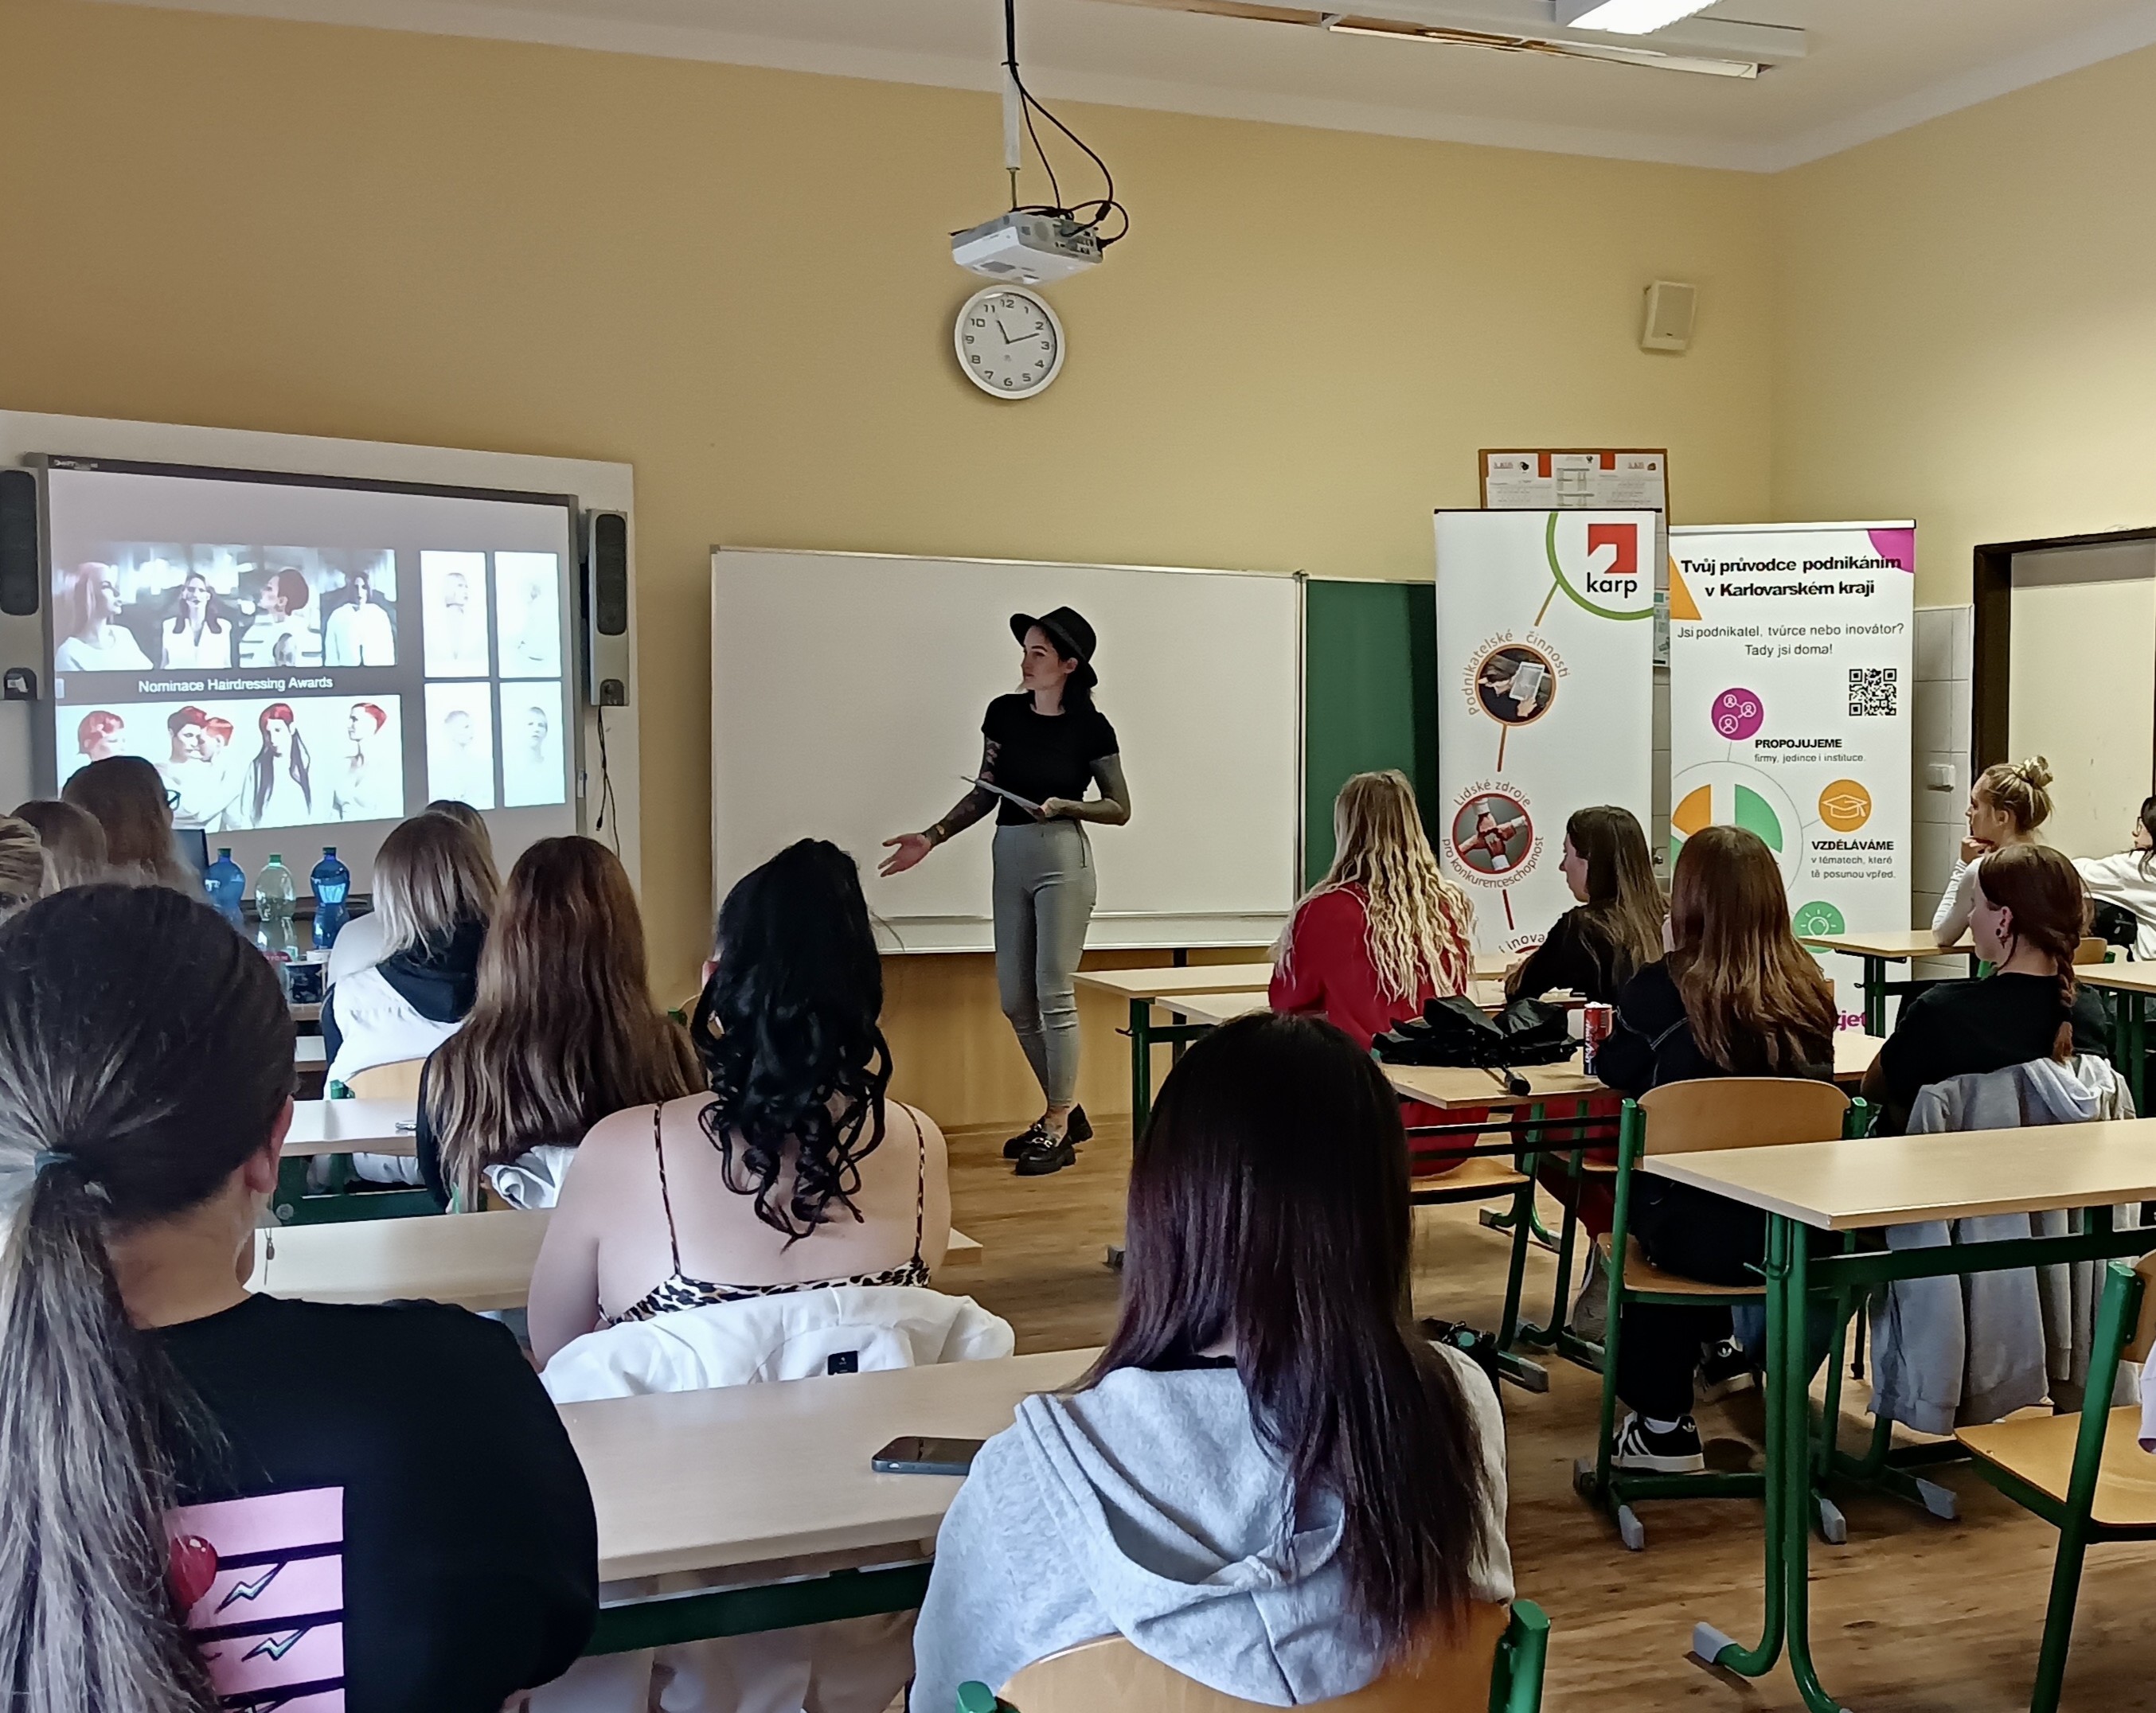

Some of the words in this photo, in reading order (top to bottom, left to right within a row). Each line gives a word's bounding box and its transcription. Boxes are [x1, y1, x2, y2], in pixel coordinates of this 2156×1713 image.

[1000, 299, 1014, 308] 12
[971, 318, 986, 327] 10
[1035, 322, 1044, 330] 2
[965, 335, 974, 344] 9
[971, 355, 981, 364] 8
[984, 371, 994, 380] 7
[1004, 377, 1013, 386] 6
[1681, 558, 1716, 576] Tvůj
[1720, 557, 1796, 576] průvodce
[1803, 556, 1902, 573] podnikáním
[1587, 572, 1638, 599] karp
[1705, 587, 1715, 597] v
[1721, 581, 1834, 597] Karlovarském
[1839, 580, 1875, 597] kraji
[1678, 626, 1694, 638] Jsi
[1697, 625, 1763, 640] podnikatel,
[1810, 624, 1841, 636] nebo
[1845, 622, 1904, 635] inovátor?
[1745, 645, 1774, 657] Tady
[1777, 644, 1791, 657] jsi
[1794, 644, 1833, 656] doma!
[1461, 629, 1513, 716] Podnikatelské
[139, 679, 205, 693] Nominace
[208, 677, 286, 692] Hairdressing
[288, 676, 334, 689] Awards
[1755, 739, 1842, 749] PROPOJUJEME
[1783, 754, 1817, 764] jedince
[1454, 778, 1491, 806] Lidské
[1496, 781, 1531, 808] zdroje
[1442, 838, 1454, 859] pro
[1811, 839, 1895, 851] VZDĚLÁVÁME
[1823, 871, 1865, 880] posunou
[1506, 933, 1546, 950] inova
